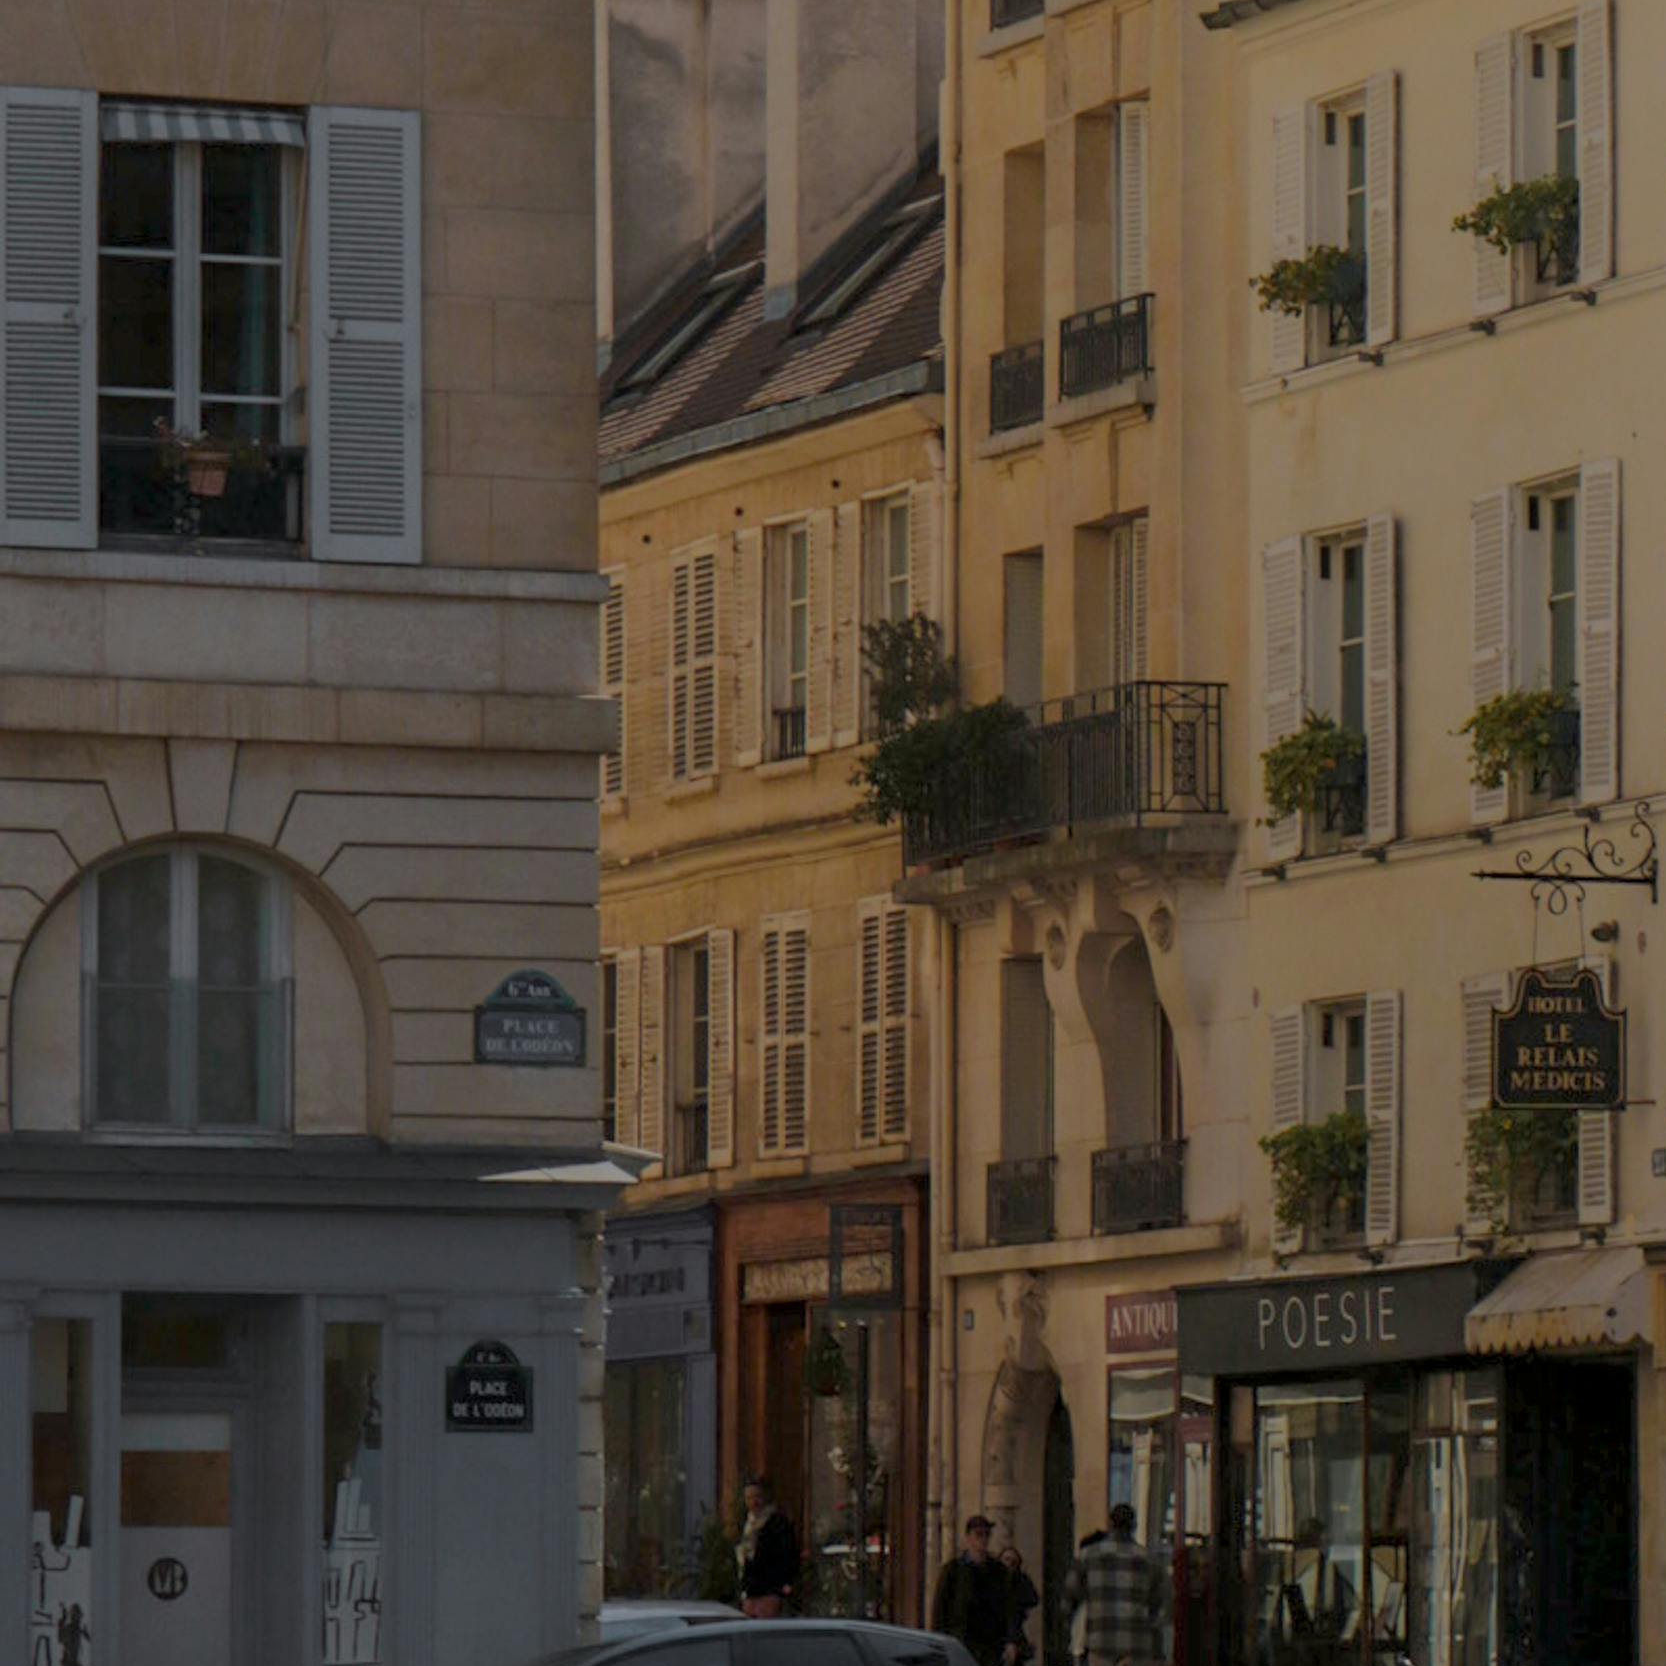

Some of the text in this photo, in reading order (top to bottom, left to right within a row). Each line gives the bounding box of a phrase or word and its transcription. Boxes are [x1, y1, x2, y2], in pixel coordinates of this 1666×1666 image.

[1528, 996, 1585, 1013] HOTEL
[503, 1018, 560, 1034] PLACE
[1544, 1023, 1573, 1043] LE
[486, 1037, 508, 1052] DE
[1517, 1046, 1599, 1068] RELAIS
[1511, 1070, 1606, 1092] MEDICIS
[1257, 1285, 1397, 1350] POESIE
[469, 1380, 507, 1396] PLACE
